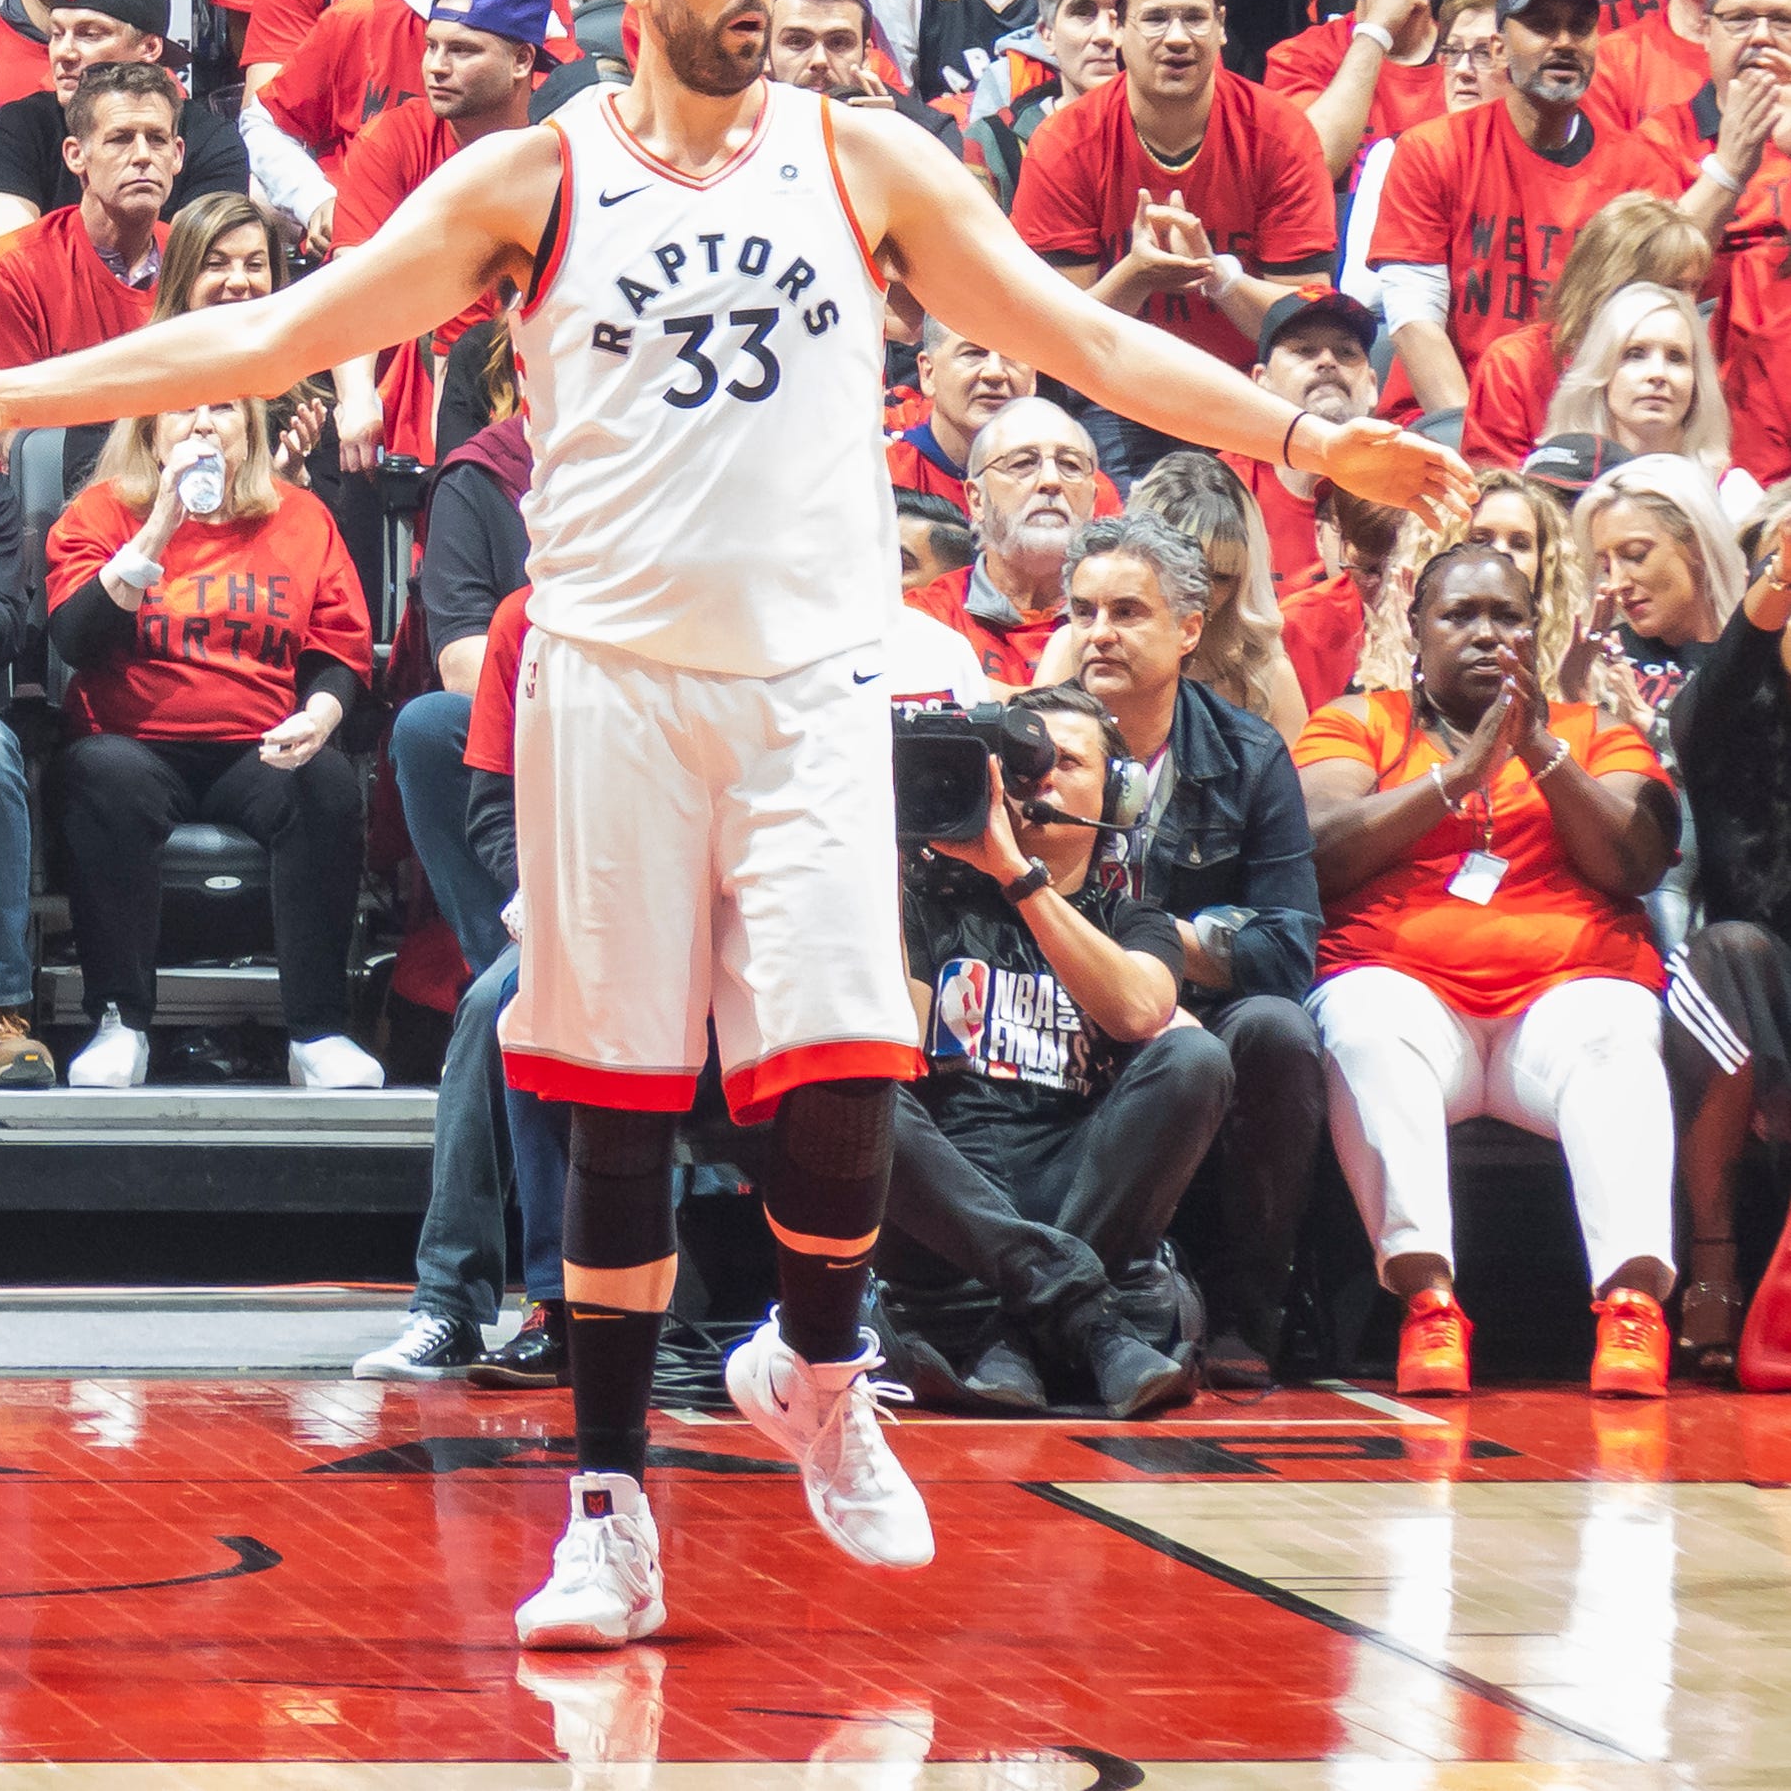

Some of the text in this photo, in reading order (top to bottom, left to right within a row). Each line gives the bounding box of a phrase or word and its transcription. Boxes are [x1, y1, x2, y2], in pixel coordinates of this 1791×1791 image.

[1472, 209, 1526, 264] WE
[592, 233, 841, 356] RAPTORS
[662, 307, 780, 409] 33
[187, 574, 292, 619] THE
[144, 615, 294, 664] ORTH
[994, 968, 1056, 1029] NBA
